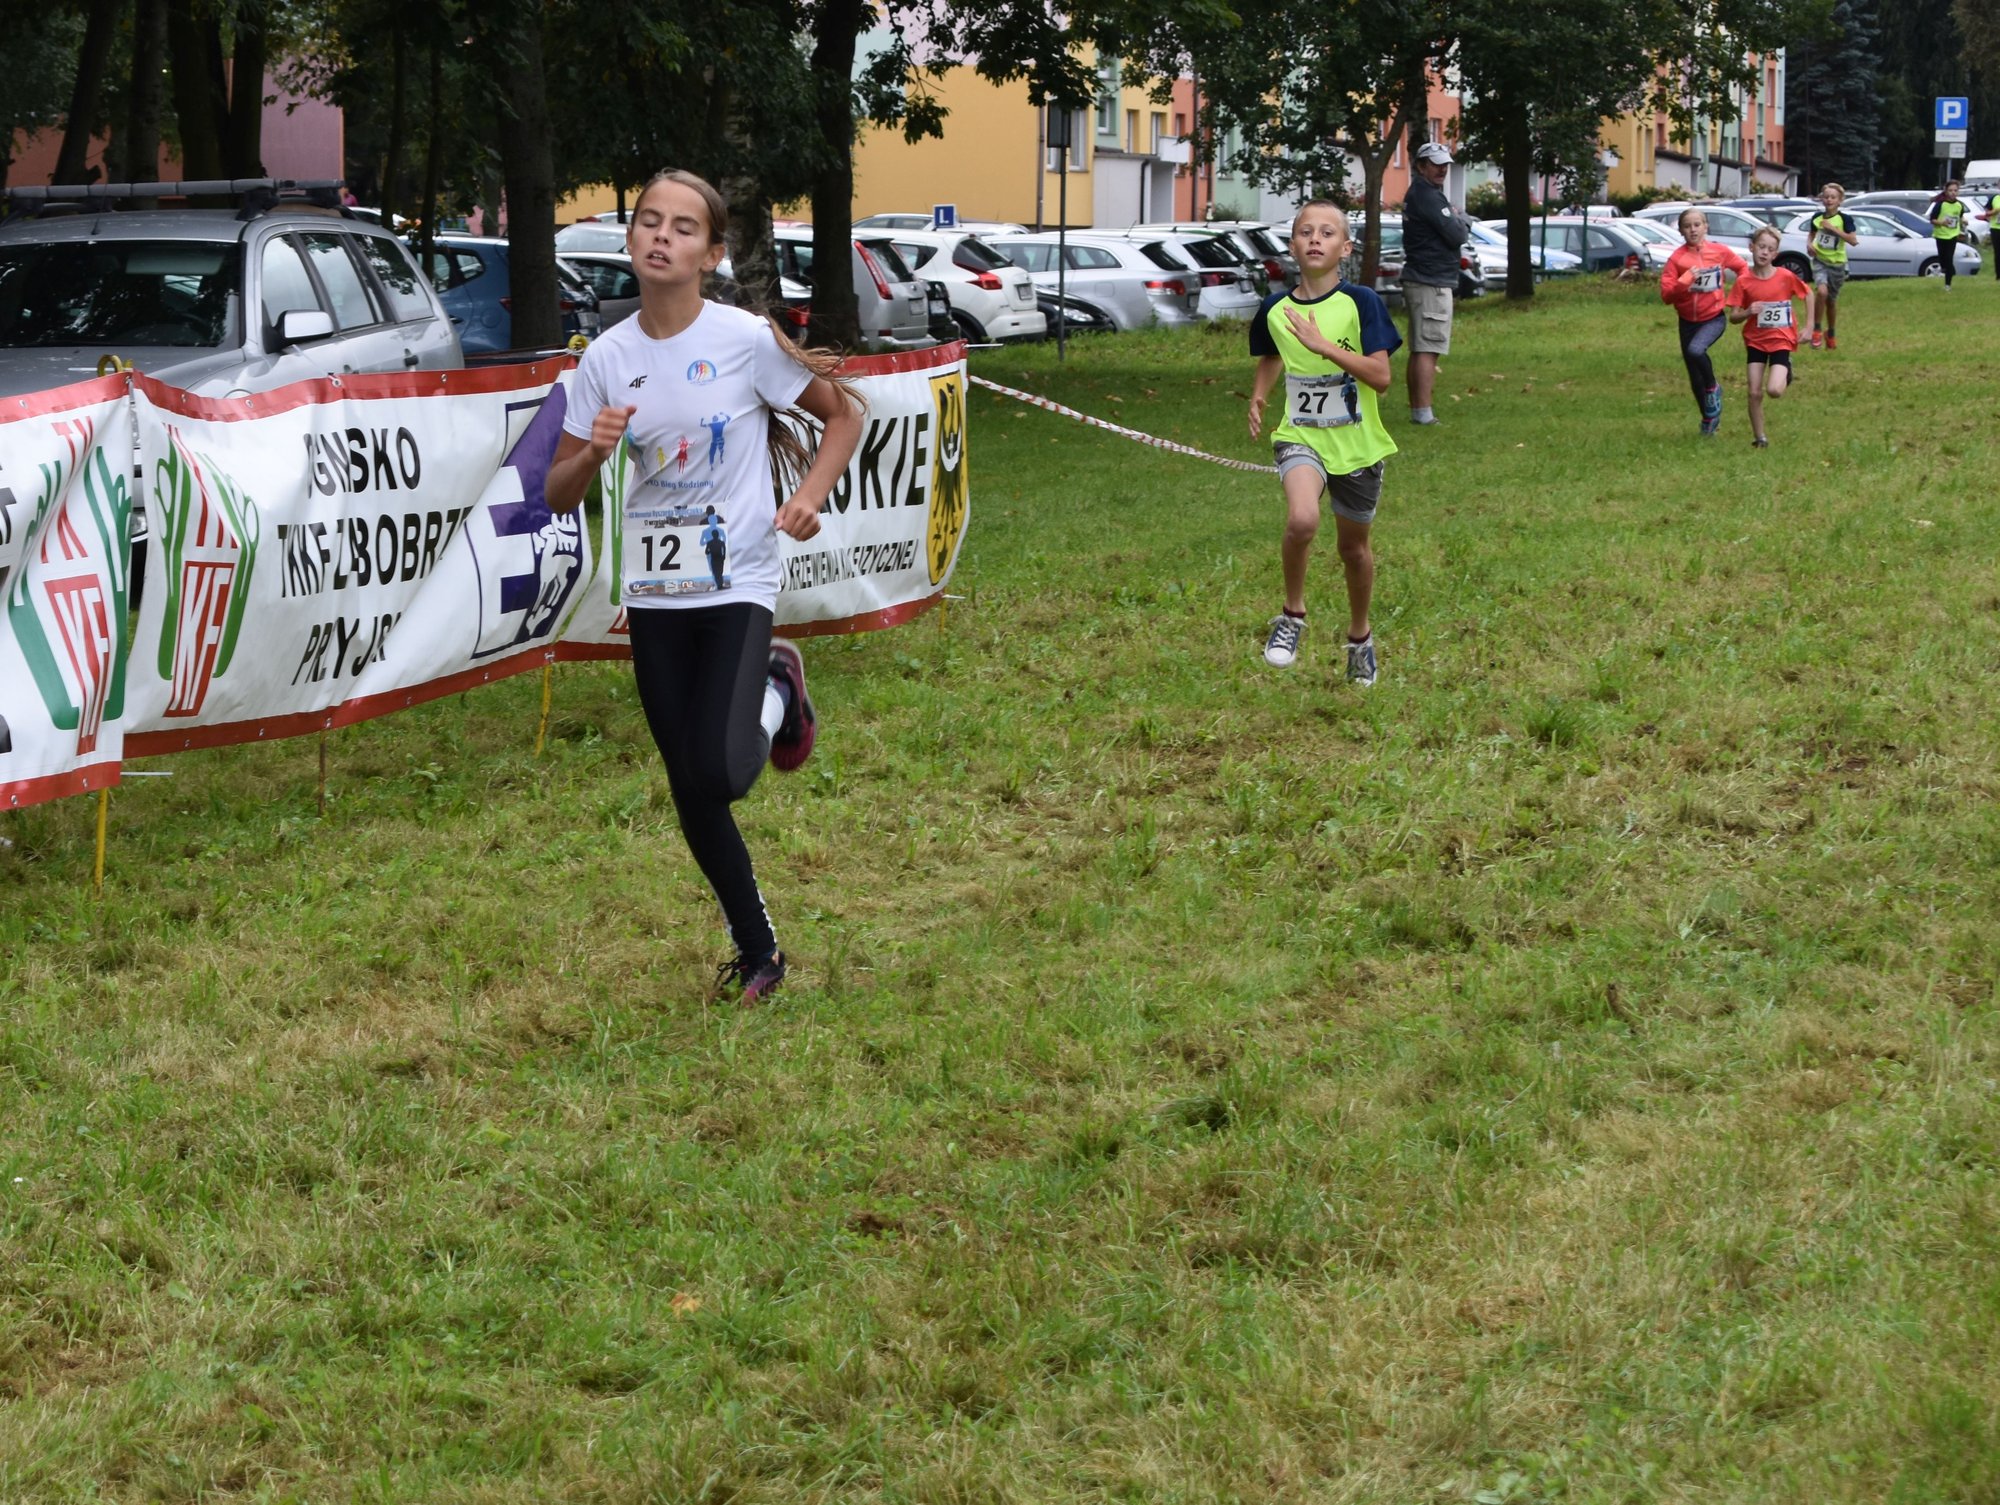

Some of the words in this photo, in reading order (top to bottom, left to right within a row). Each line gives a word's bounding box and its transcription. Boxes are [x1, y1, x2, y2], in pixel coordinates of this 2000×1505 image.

[1943, 101, 1961, 126] P
[939, 208, 950, 224] L
[1695, 275, 1711, 286] 47
[1763, 310, 1781, 322] 35
[1298, 391, 1329, 414] 27
[678, 479, 714, 490] Rodzinny
[277, 521, 331, 598] TKKF
[641, 534, 681, 572] 12
[853, 538, 919, 576] FIZYCZNEJ
